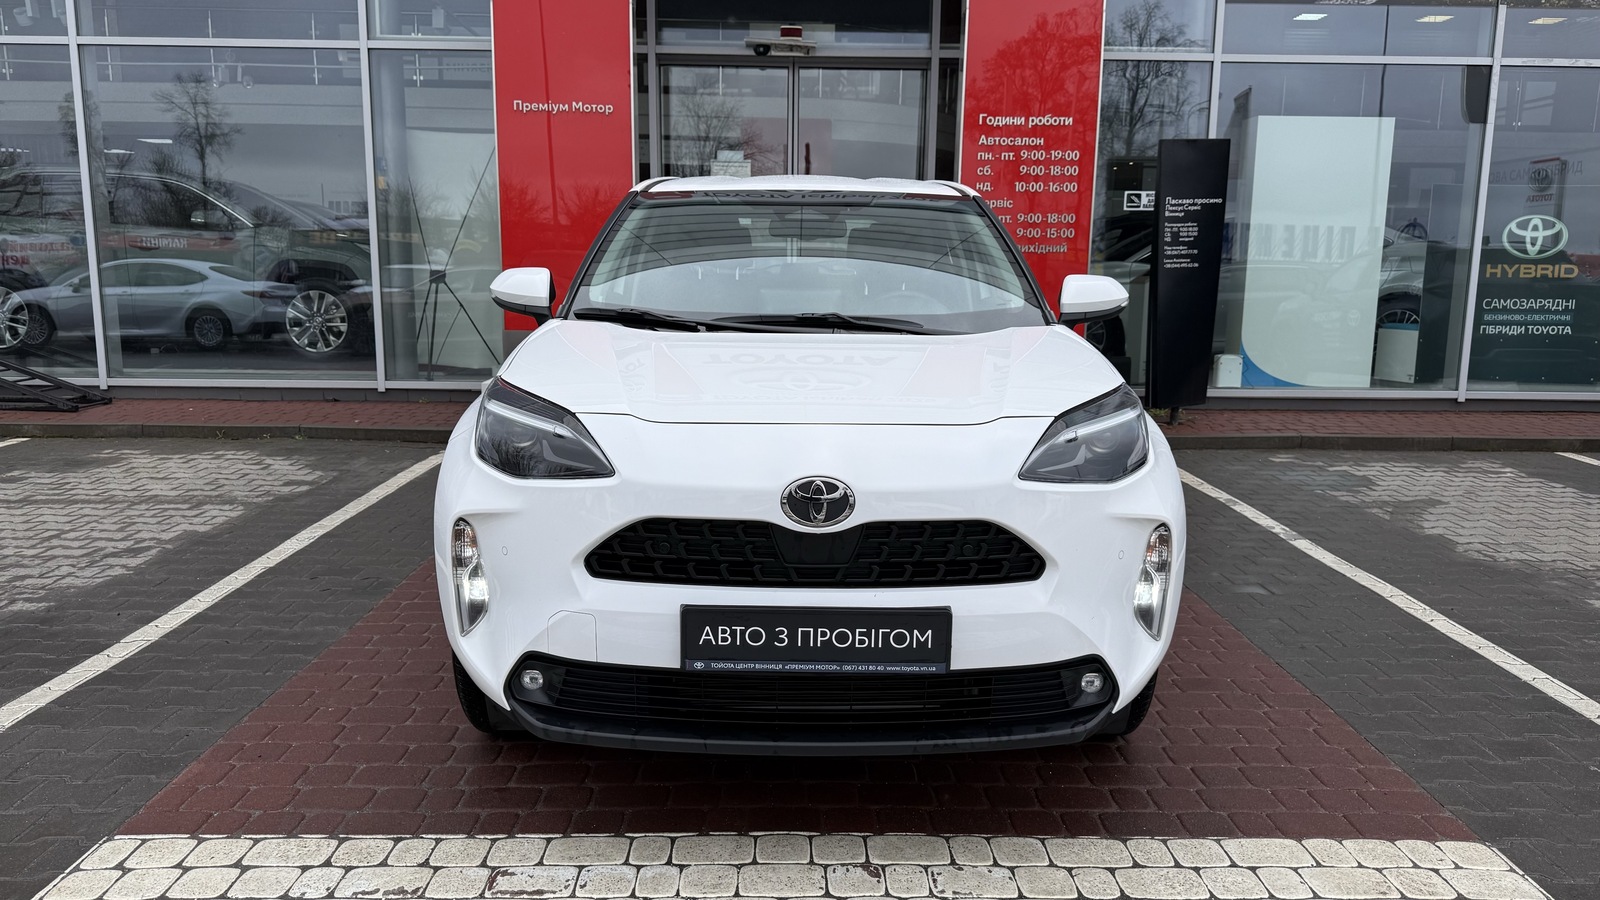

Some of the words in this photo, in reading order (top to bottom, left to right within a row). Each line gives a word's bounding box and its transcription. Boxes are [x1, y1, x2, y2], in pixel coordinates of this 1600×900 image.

[513, 99, 568, 114] Преміум
[572, 101, 614, 115] Мотор
[978, 113, 1025, 127] Години
[1028, 113, 1073, 128] роботи
[978, 134, 1044, 145] Автосалон
[1020, 150, 1080, 161] 9:00-19:00
[977, 165, 994, 175] сб.
[1019, 165, 1079, 176] 9:00-18:00
[976, 182, 994, 192] нд.
[1014, 181, 1078, 192] 10:00-16:00
[1165, 197, 1193, 205] Ласкаво
[1017, 213, 1076, 223] 9:00-18:00
[1016, 228, 1075, 238] 9:00-15:00
[1485, 264, 1579, 278] HYBRID
[1482, 298, 1576, 311] САМОЗАРЯДНІ
[1480, 325, 1525, 335] ГІБРИДИ
[1527, 325, 1572, 335] TOYOTA
[699, 626, 766, 646] АВТО
[774, 627, 789, 646] З
[798, 627, 933, 649] ПРОБІГОМ
[711, 661, 734, 669] ТОЙОТА
[735, 662, 754, 670] ЦЕНТР
